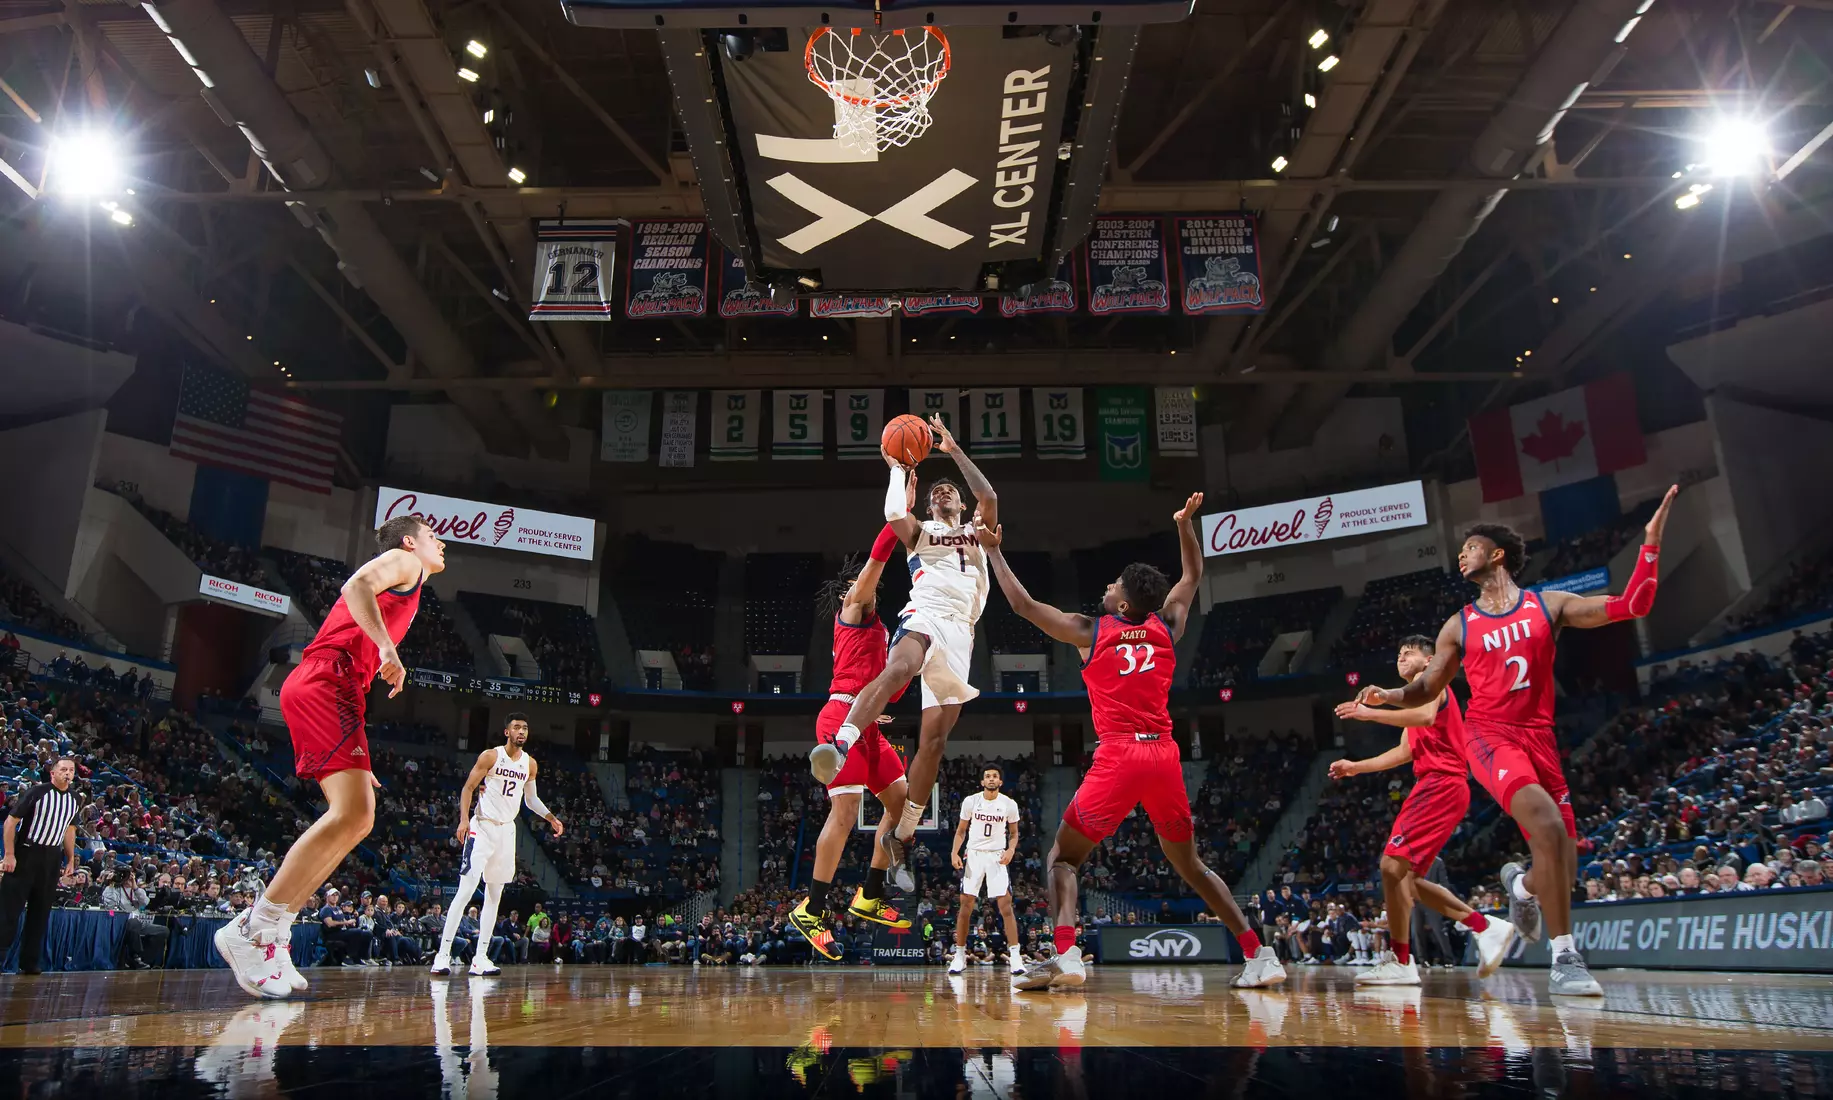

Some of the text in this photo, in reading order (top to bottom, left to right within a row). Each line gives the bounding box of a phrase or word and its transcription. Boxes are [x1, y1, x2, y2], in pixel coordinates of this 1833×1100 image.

[988, 64, 1051, 249] XL CENTER
[636, 223, 703, 234] 1999-2000
[1096, 219, 1155, 229] 2003-2004
[1186, 219, 1246, 228] 2014-2015
[1099, 229, 1152, 239] EASTERN
[1181, 228, 1252, 237] NORTHEAST
[640, 235, 697, 246] REGULAR
[1090, 240, 1159, 249] CONFERENCE
[1191, 236, 1244, 246] DIVISION
[643, 246, 693, 257] SEASON
[1090, 249, 1158, 259] CHAMPIONS
[1183, 245, 1254, 255] CHAMPIONS
[633, 258, 703, 269] CHAMPIONS
[546, 261, 600, 296] 12
[727, 415, 744, 442] 2
[789, 414, 808, 440] 5
[851, 413, 868, 441] 9
[981, 412, 1009, 438] 11
[1043, 413, 1077, 441] 19
[1339, 502, 1411, 519] PROUDLY SERVED
[1341, 512, 1412, 529] AT THE XL CENTER
[518, 527, 582, 543] PROUDLY SERVED
[1211, 509, 1306, 552] Carvel
[517, 536, 527, 544] AT
[528, 538, 543, 547] THE
[553, 541, 582, 552] CENTER
[956, 547, 966, 573] 1
[209, 579, 239, 592] RICOH
[513, 579, 532, 590] 233
[254, 591, 283, 604] RICOH
[1121, 630, 1147, 641] MAYO
[1482, 618, 1532, 652] NJIT
[1115, 642, 1156, 677] 32
[442, 675, 452, 684] 19
[1505, 655, 1532, 692] 2
[489, 682, 502, 691] 35
[495, 767, 527, 781] UCONN
[502, 779, 517, 797] 12
[974, 812, 1004, 823] UCONN
[983, 823, 993, 838] 0
[1574, 910, 1833, 951] HOME OF THE HUSKI
[873, 948, 925, 958] TRAVELERS
[1129, 938, 1188, 958] SNY
